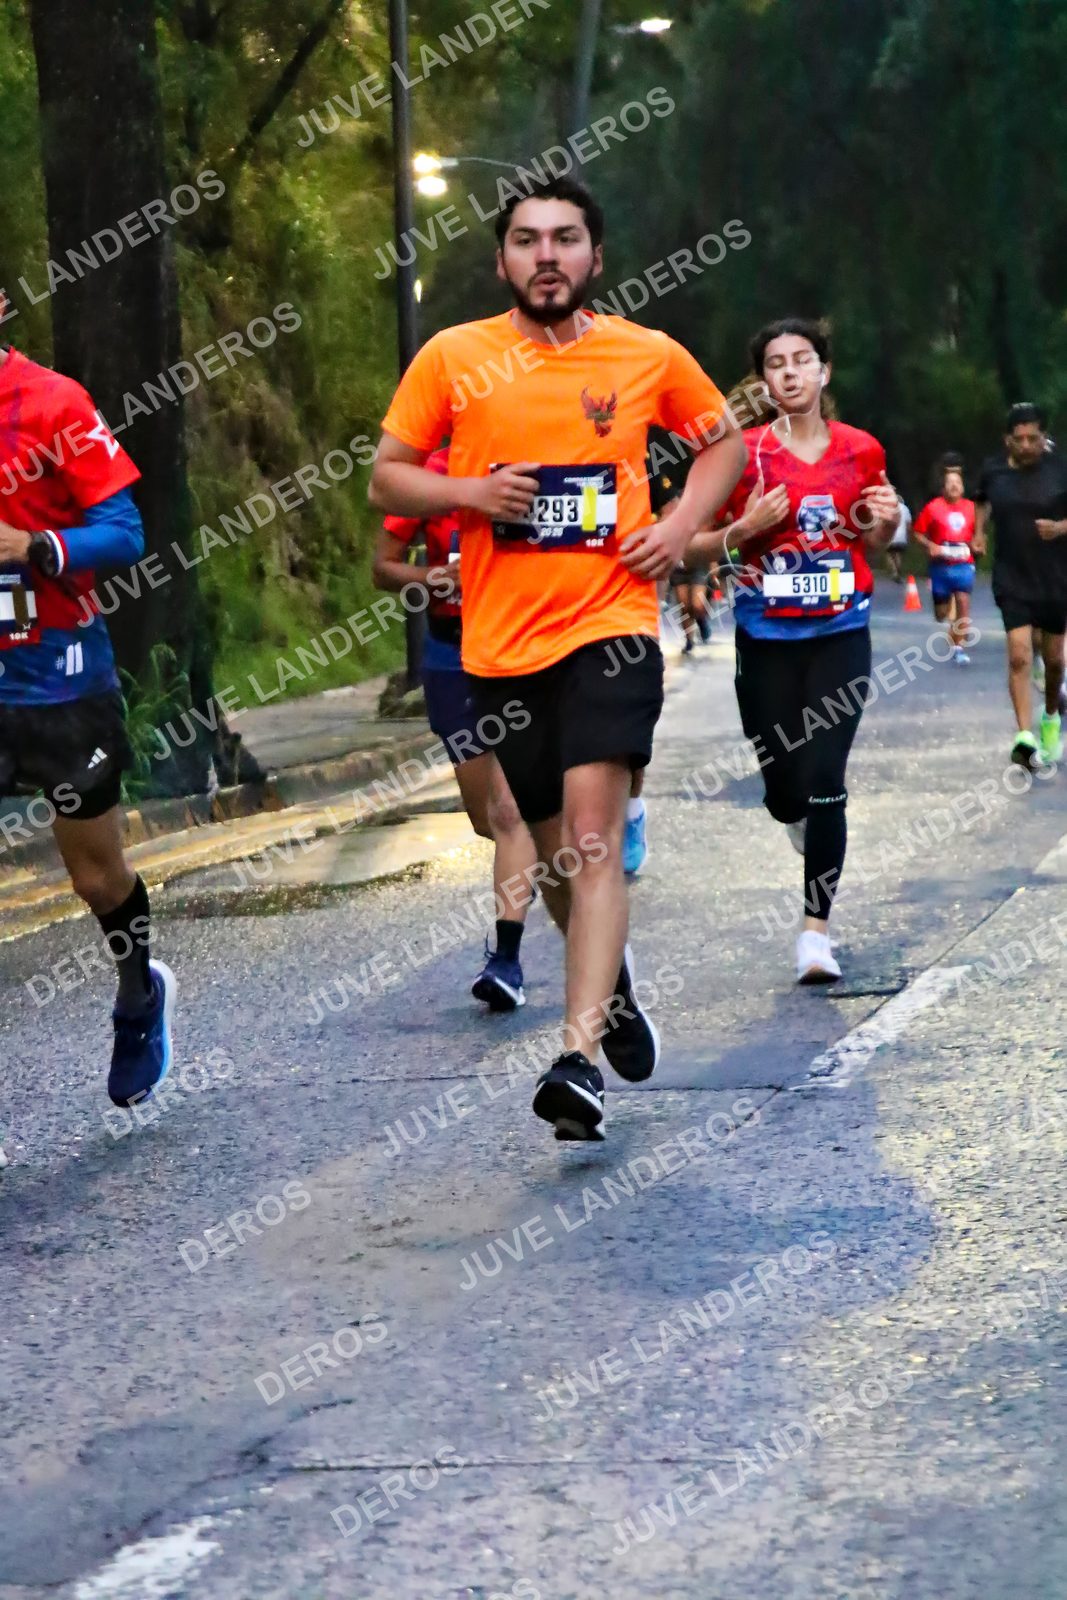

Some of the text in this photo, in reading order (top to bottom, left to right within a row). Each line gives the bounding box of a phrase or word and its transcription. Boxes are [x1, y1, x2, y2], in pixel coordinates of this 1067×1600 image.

[525, 497, 579, 523] 293
[792, 575, 827, 594] 5310
[9, 632, 29, 641] 10K
